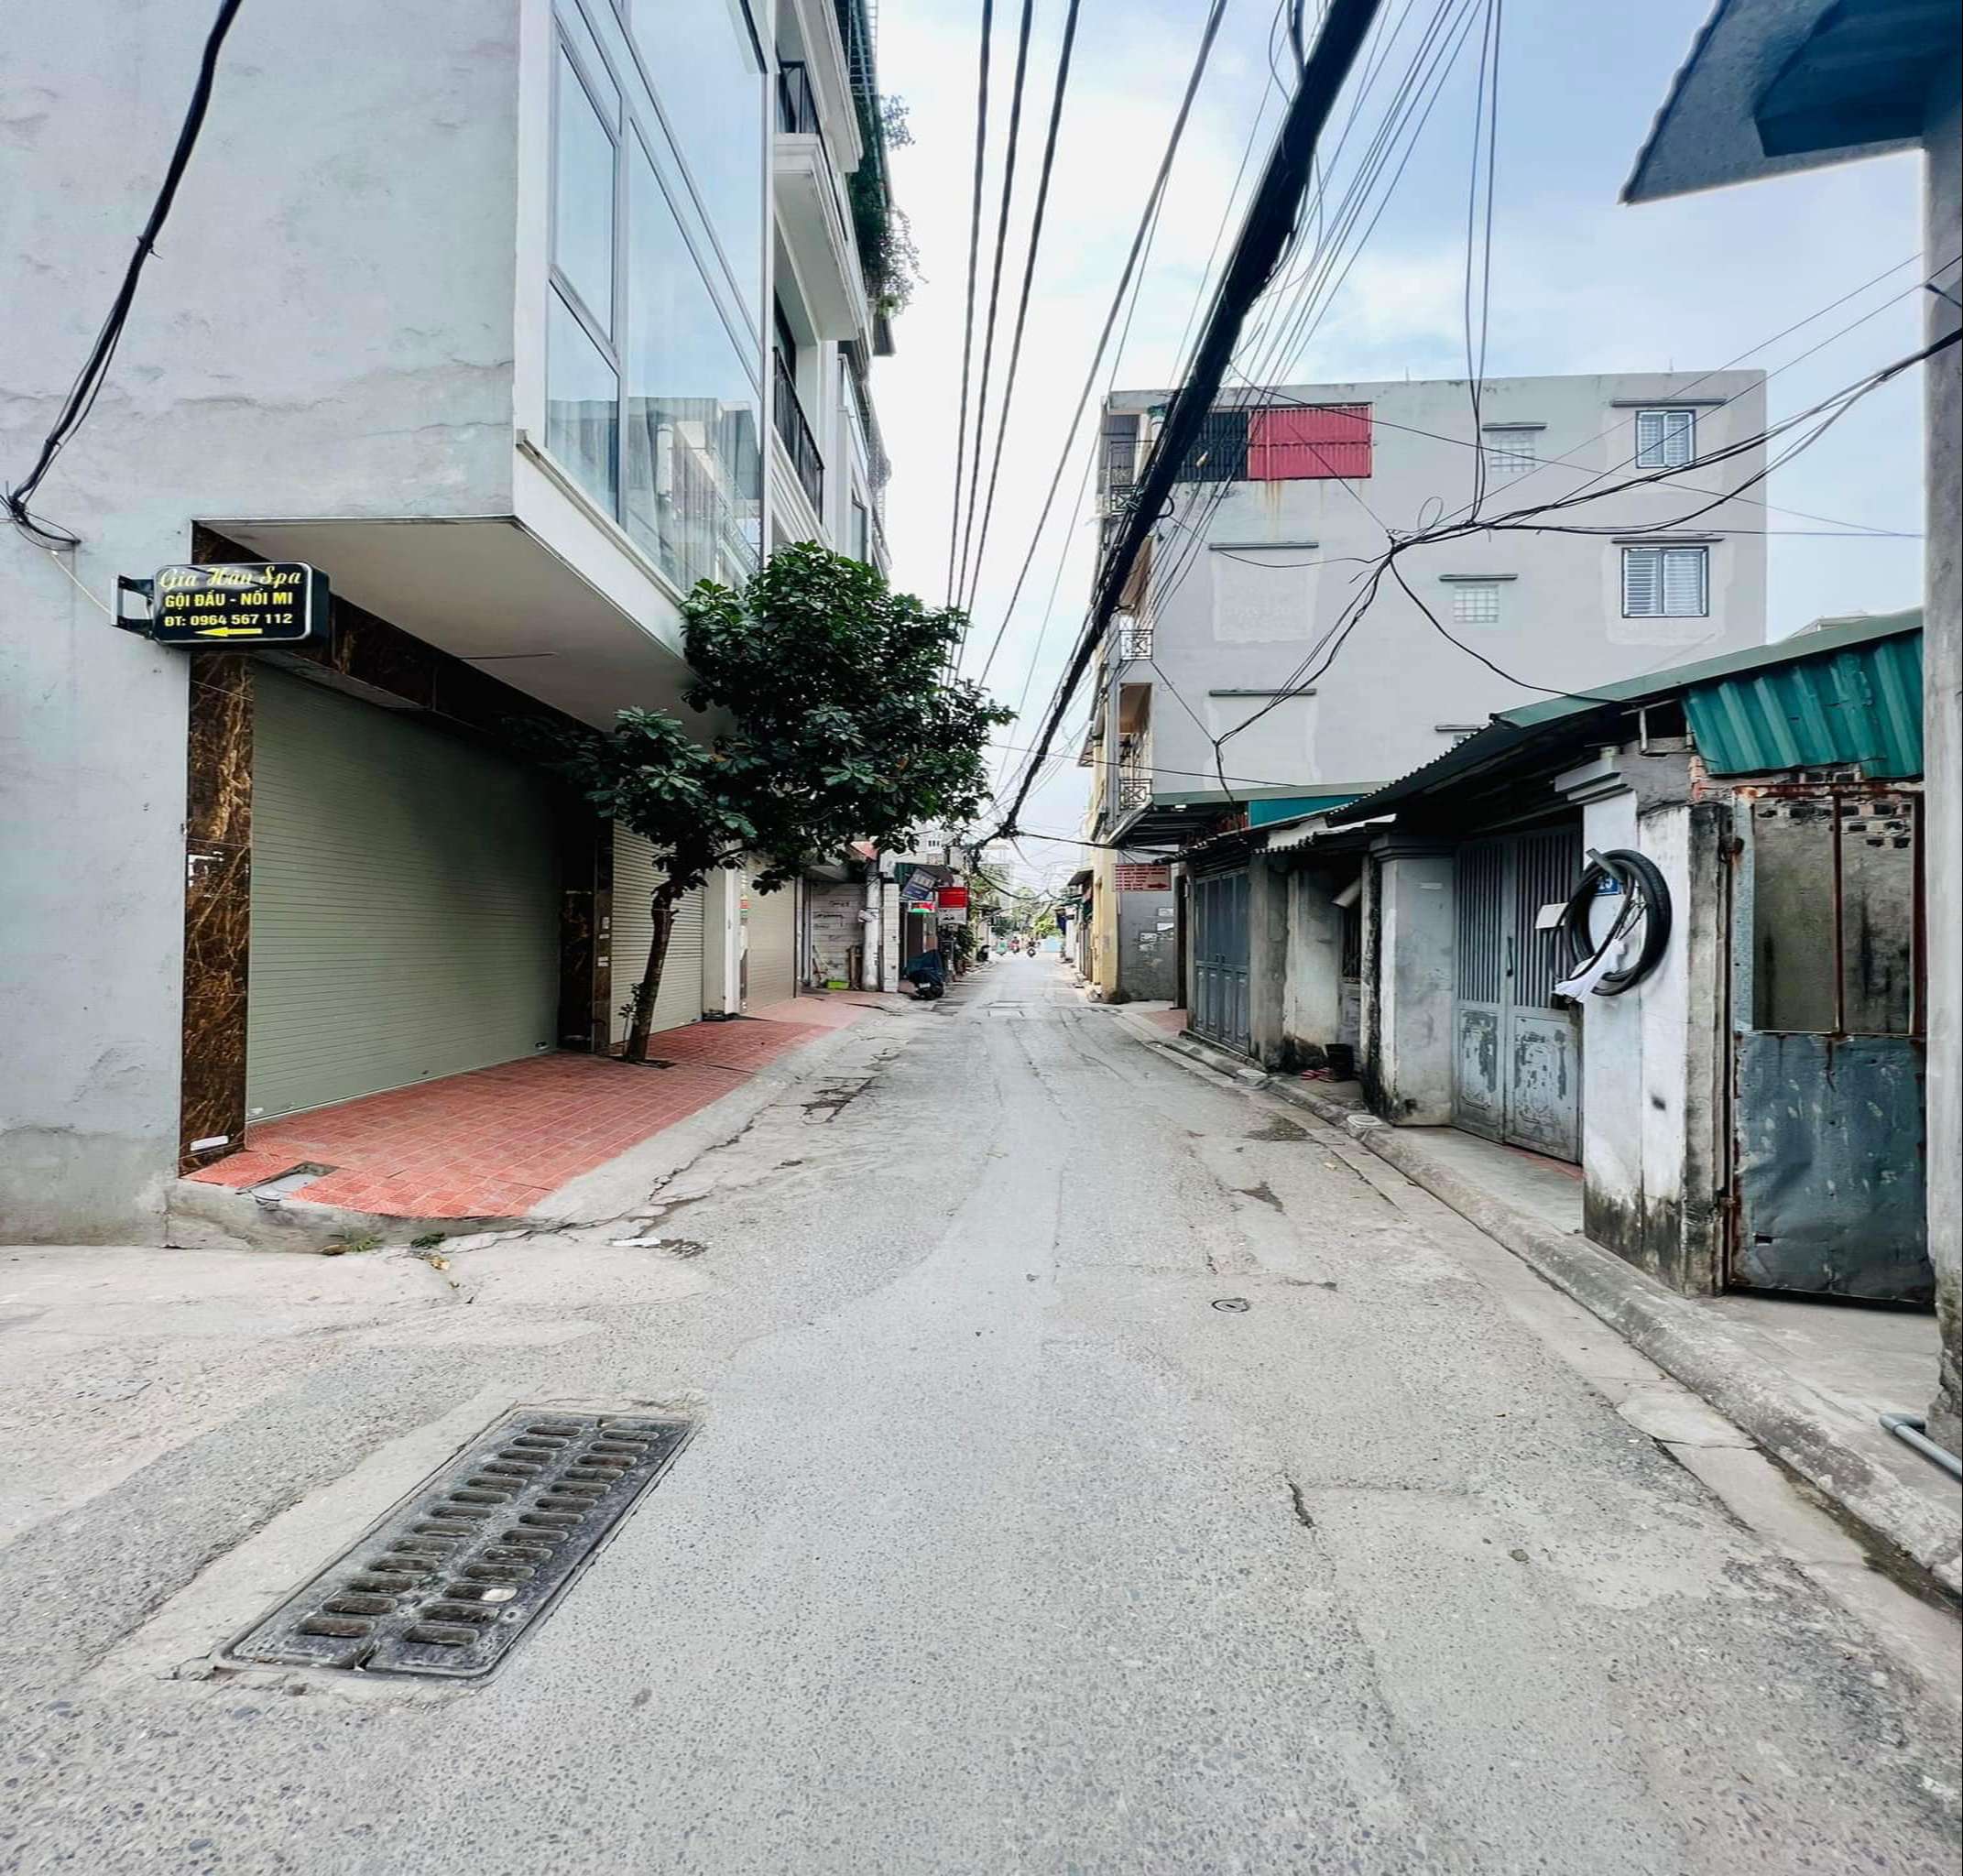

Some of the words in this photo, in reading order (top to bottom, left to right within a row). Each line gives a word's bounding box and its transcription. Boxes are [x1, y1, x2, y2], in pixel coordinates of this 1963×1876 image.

[161, 568, 197, 592] Gia
[259, 565, 301, 589] Spa
[166, 592, 191, 610] GỘI
[194, 589, 225, 606] ĐẤU
[241, 588, 268, 605] NỐI
[273, 592, 292, 605] MI
[164, 616, 186, 627] ĐT:
[191, 615, 227, 626] 0964
[231, 614, 259, 625] 567
[265, 613, 293, 624] 112
